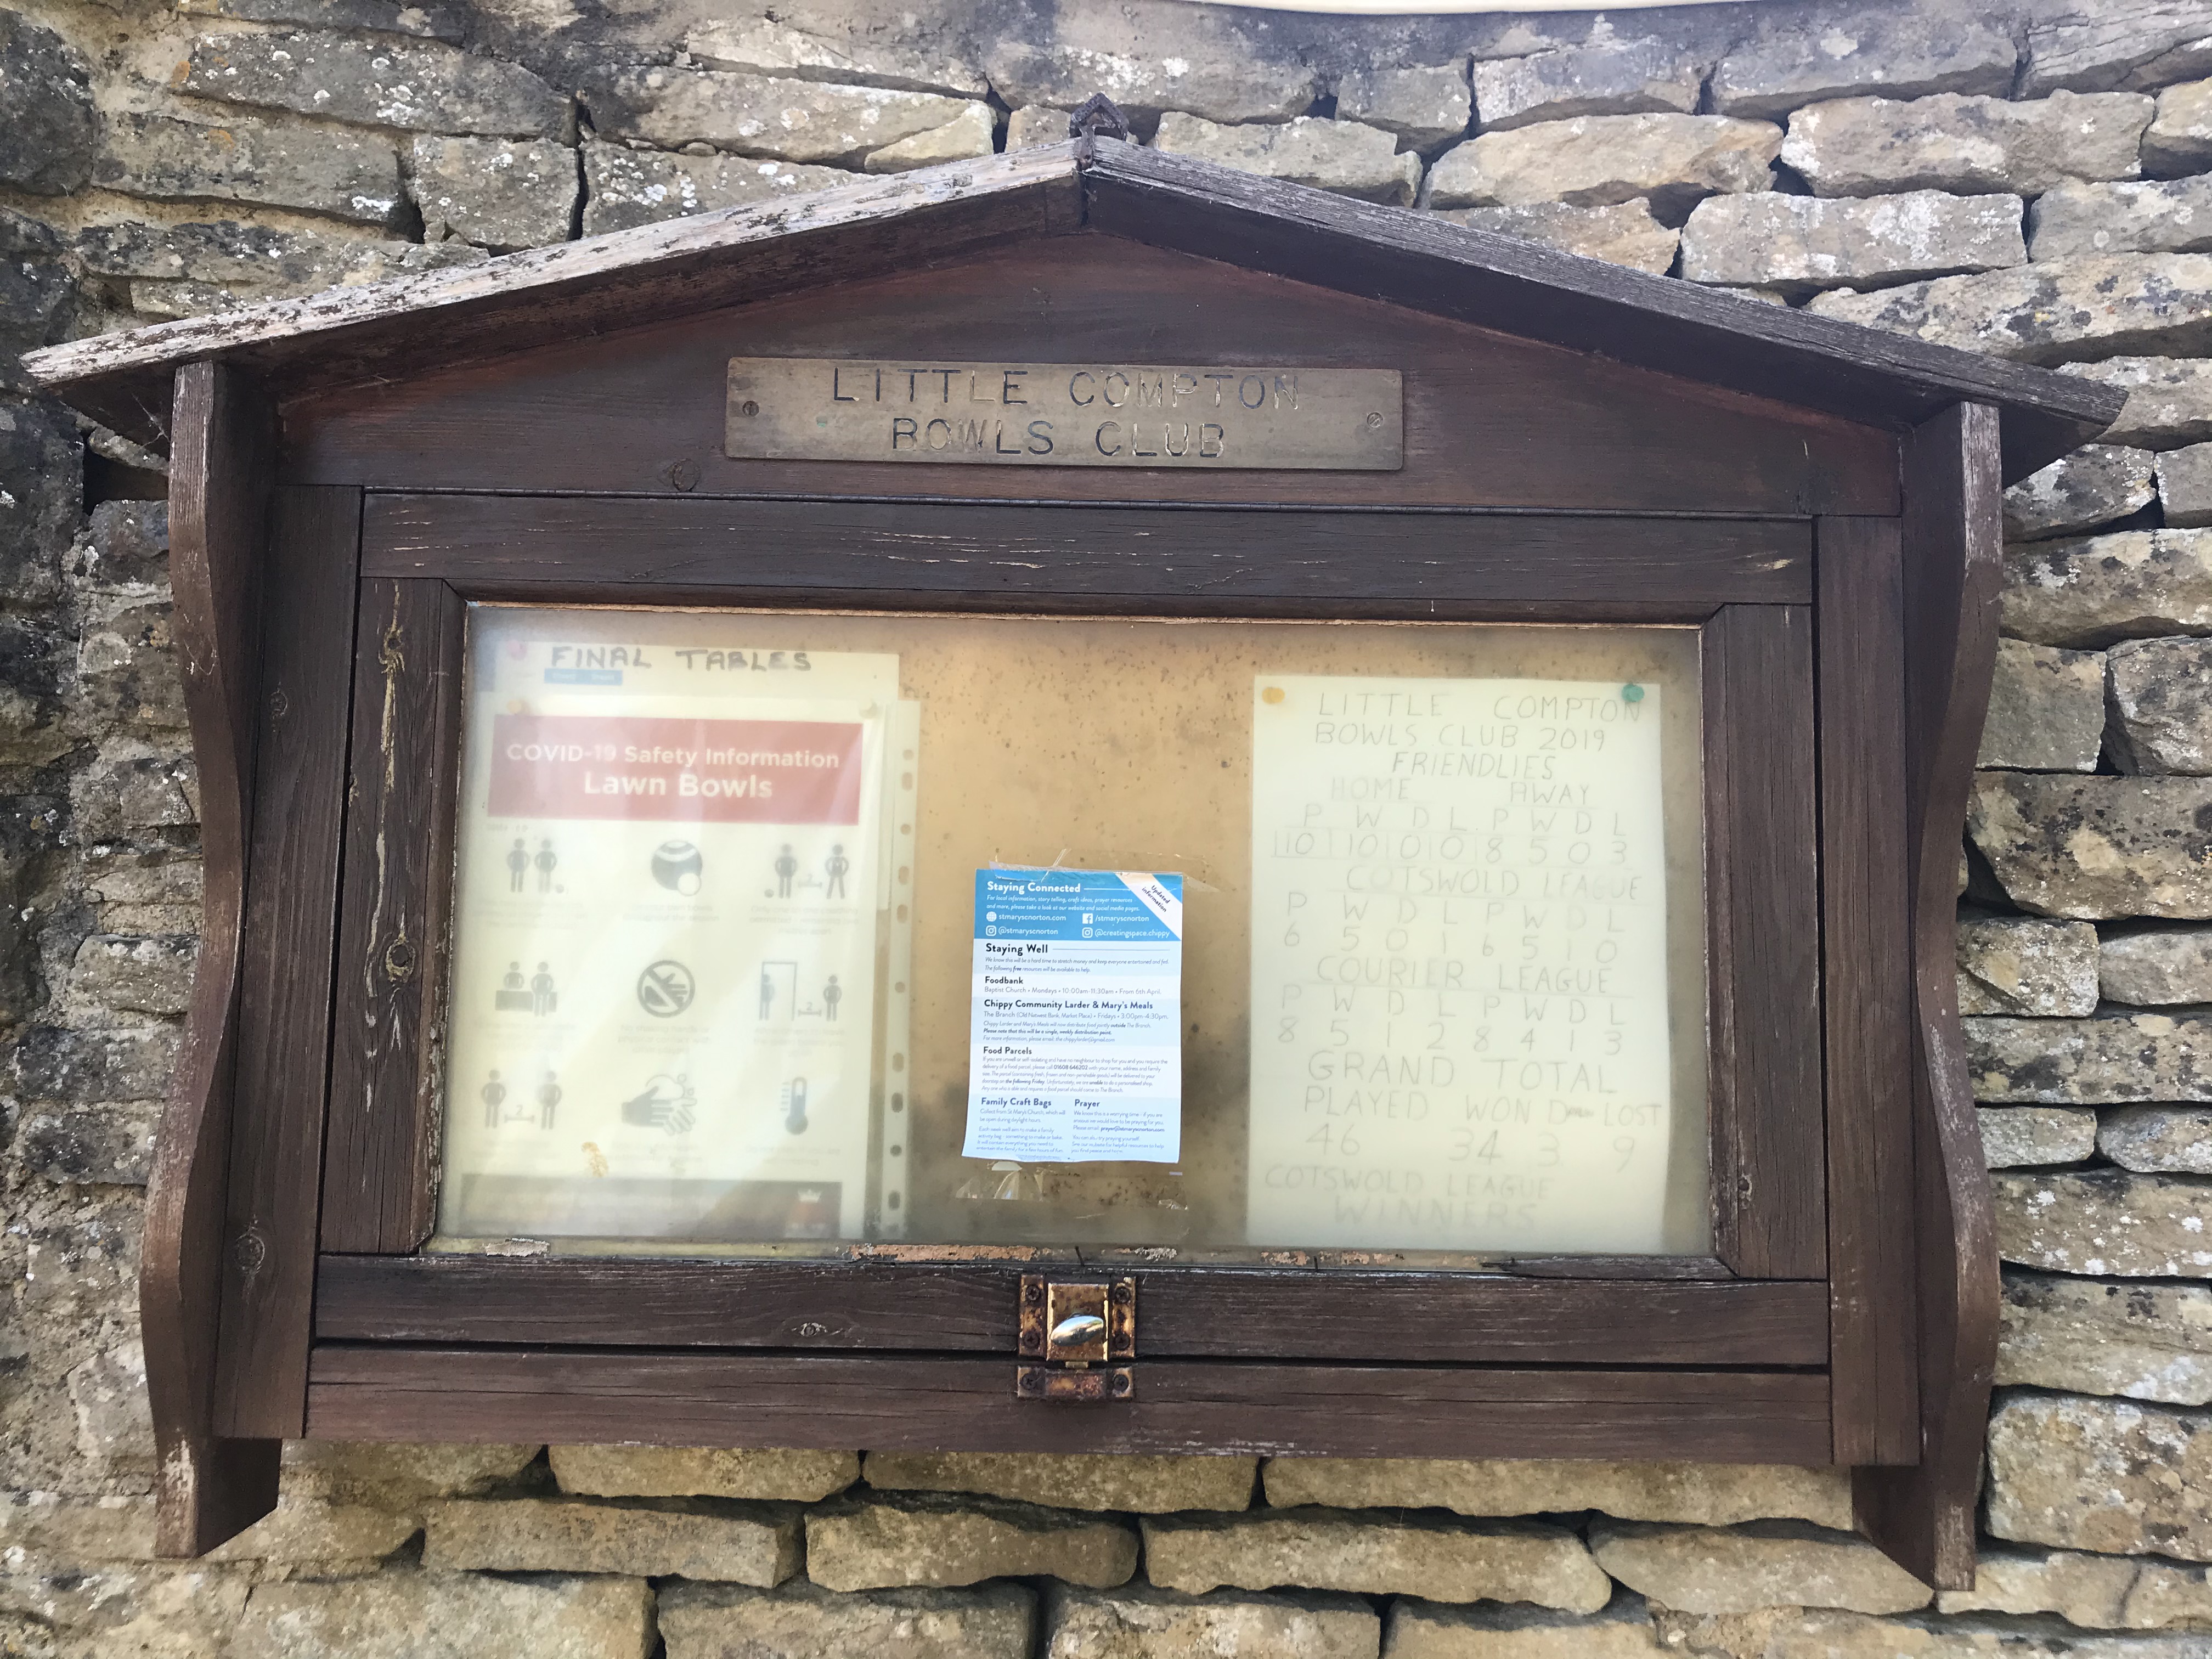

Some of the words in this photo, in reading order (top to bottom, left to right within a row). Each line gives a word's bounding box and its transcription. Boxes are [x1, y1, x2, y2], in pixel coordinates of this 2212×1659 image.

[833, 366, 1029, 405] LITTLE
[1069, 371, 1299, 410] COMPTON
[893, 417, 1054, 455] BOWLS
[1096, 421, 1224, 458] CLUB
[551, 646, 652, 669] FINAL
[675, 648, 812, 672] TABLES
[1319, 692, 1452, 718] LITTLE
[1494, 696, 1640, 722] COMPTON
[1315, 722, 1417, 747] BOWLS
[1439, 724, 1519, 749] CLUB
[1539, 727, 1606, 752] 2019
[506, 743, 617, 763] COVID-19
[624, 746, 697, 769] Safety
[706, 748, 840, 769] Information
[1391, 752, 1556, 780] FRIENDLIES
[583, 773, 666, 797] Lawn
[678, 775, 773, 799] Bowls
[1330, 778, 1412, 801] HOME
[1510, 781, 1590, 805] AWAY
[1304, 803, 1323, 827] P
[1356, 805, 1383, 829] W
[1412, 807, 1430, 830] D
[1451, 807, 1467, 831] L
[1492, 808, 1508, 832] P
[1530, 811, 1557, 833] W
[1575, 812, 1592, 834] D
[1614, 813, 1626, 837] L
[988, 881, 1025, 895] Staying
[1028, 882, 1080, 892] Connected
[1152, 885, 1171, 904] Updated
[1347, 865, 1520, 896] COTSWOLD
[1544, 872, 1641, 902] LEAGUE
[1142, 887, 1166, 912] information
[1288, 891, 1307, 918] P
[1344, 896, 1369, 921] W
[1397, 896, 1417, 924] D
[1443, 900, 1458, 925] L
[1486, 902, 1504, 926] P
[1523, 905, 1548, 929] W
[1609, 907, 1625, 933] L
[998, 926, 1058, 936] @stmaryscnorton
[999, 914, 1066, 922] stmaryscnorton.com
[1095, 915, 1149, 923] /stmaryscnorton
[1095, 929, 1170, 938] @creatingspace.chippy
[1284, 921, 1301, 947] 6
[1342, 926, 1359, 952] 5
[1386, 929, 1408, 952] 0
[1482, 932, 1494, 958] 6
[1522, 935, 1539, 961] 5
[1596, 940, 1618, 963] 0
[986, 943, 1023, 956] Staying
[1026, 944, 1048, 953] Well
[1317, 955, 1465, 989] COURIER
[1498, 963, 1612, 994] LEAGUE
[984, 999, 1013, 1010] Chippy
[1015, 1000, 1062, 1011] Community
[1282, 984, 1302, 1010] P
[1334, 986, 1356, 1013] W
[1388, 989, 1405, 1015] D
[1438, 990, 1456, 1017] L
[1483, 996, 1501, 1019] P
[1523, 997, 1548, 1021] W
[1570, 998, 1586, 1024] D
[1610, 999, 1626, 1025] L
[1277, 1018, 1297, 1043] 8
[1330, 1019, 1350, 1046] 5
[1427, 1023, 1446, 1049] 2
[1472, 1026, 1492, 1052] 8
[1520, 1029, 1535, 1052] 4
[1604, 1031, 1622, 1055] 3
[1308, 1050, 1455, 1087] GRAND
[1481, 1058, 1618, 1094] TOTAL
[981, 1097, 1008, 1108] Family
[1034, 1098, 1052, 1109] Bags
[1075, 1099, 1100, 1109] Prayer
[1304, 1086, 1429, 1121] PLAYED
[1466, 1095, 1531, 1124] WON
[1605, 1103, 1661, 1127] LOST
[1306, 1124, 1361, 1155] 46
[1448, 1127, 1502, 1164] 34
[1537, 1132, 1560, 1167] 3
[1613, 1136, 1635, 1172] 9
[1266, 1163, 1425, 1192] COTSWOLD
[1446, 1171, 1555, 1199] LEAGUE
[1334, 1194, 1537, 1229] WINNERS
